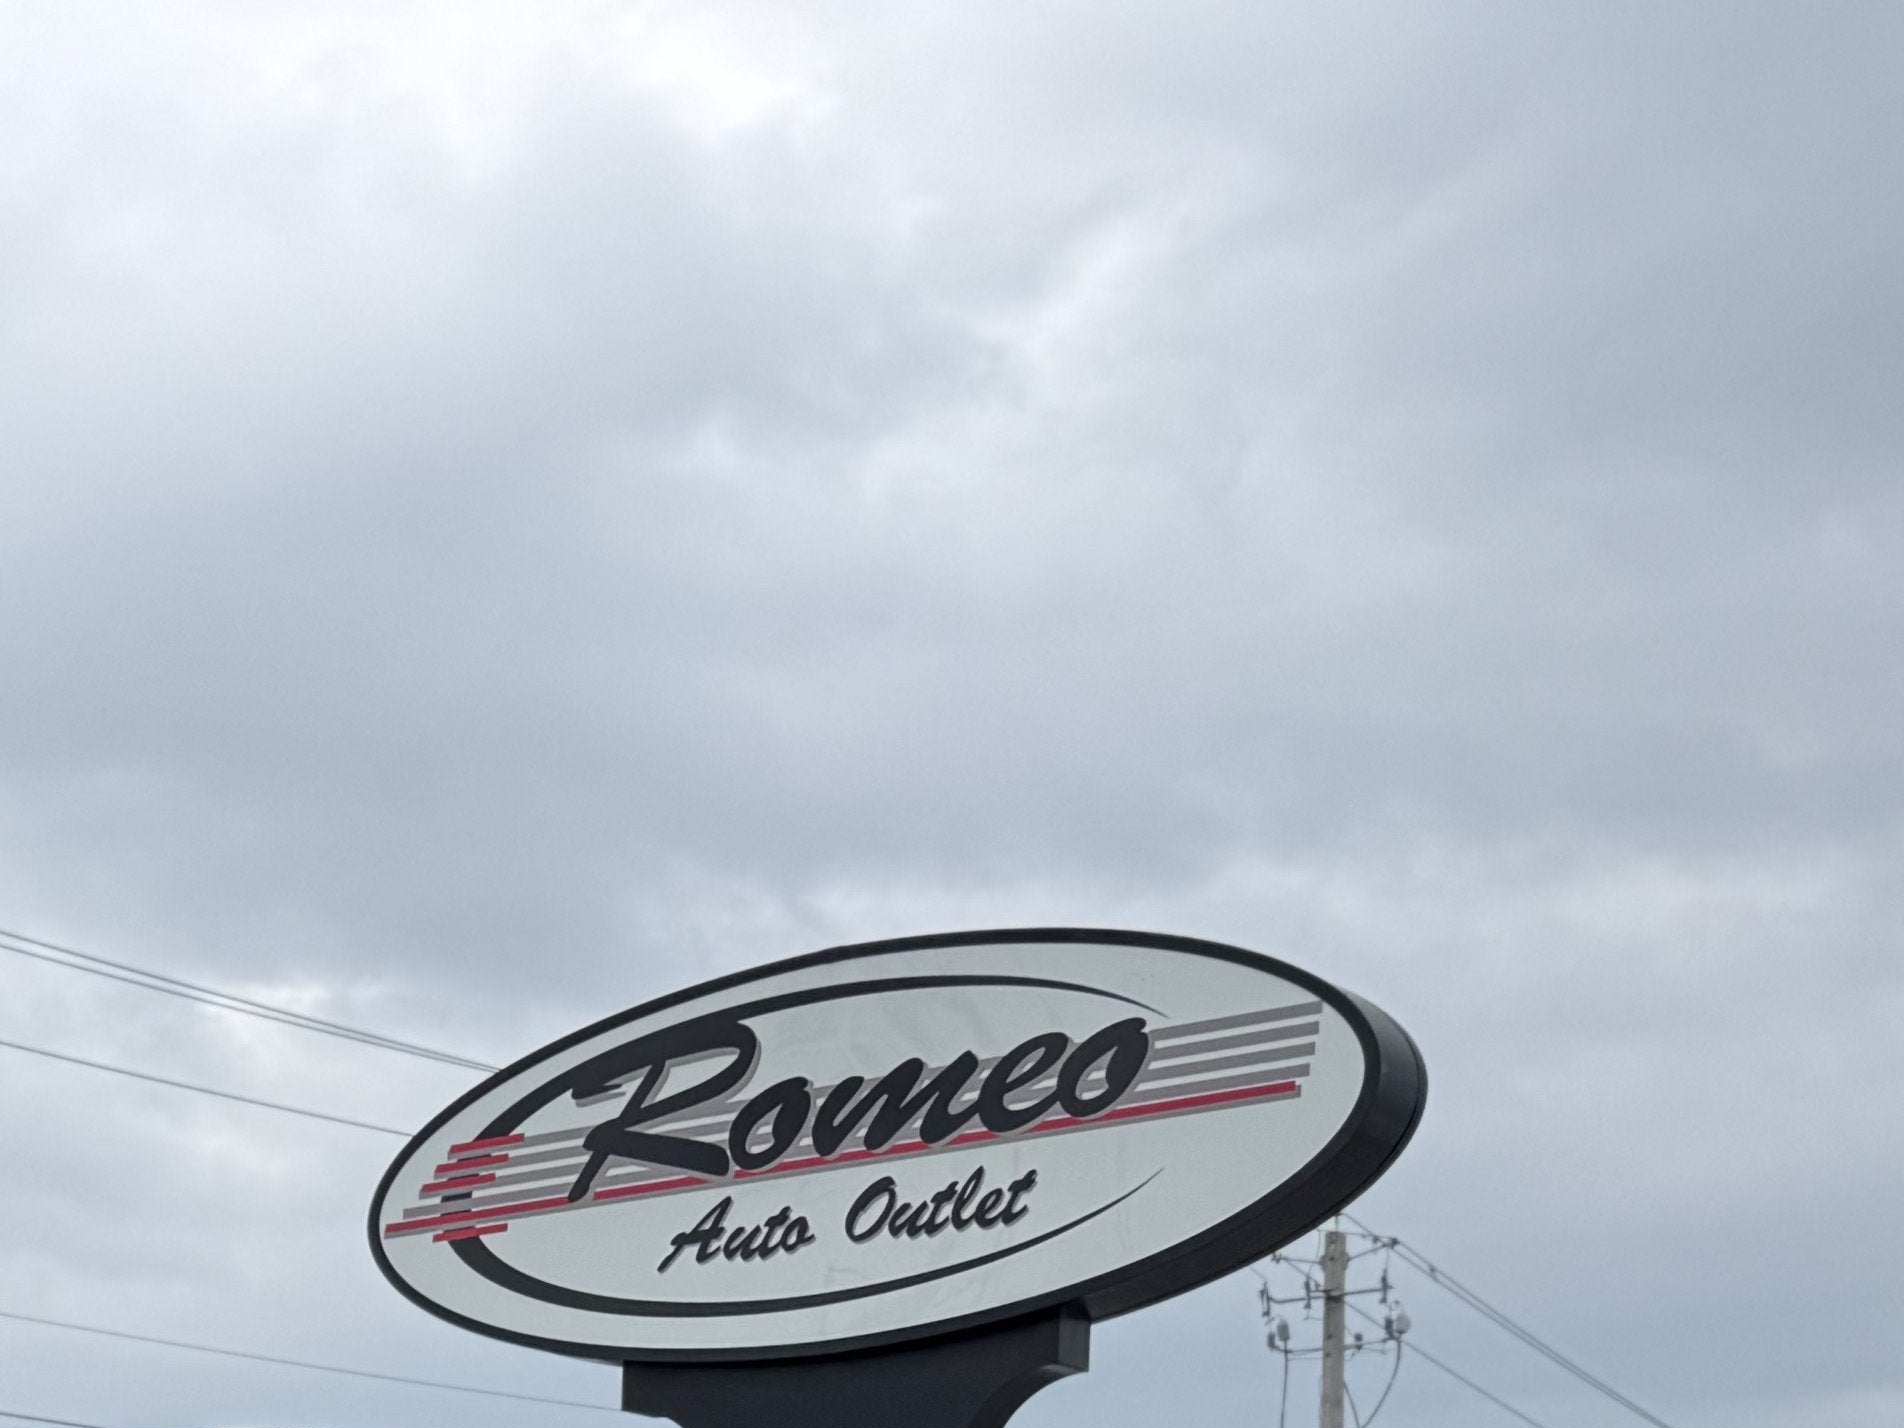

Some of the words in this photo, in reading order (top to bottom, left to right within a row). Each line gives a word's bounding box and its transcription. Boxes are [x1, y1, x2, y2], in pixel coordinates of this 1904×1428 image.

[568, 1015, 1150, 1202] Romeo
[657, 1196, 816, 1274] Auto
[844, 1165, 1039, 1243] Outlet
